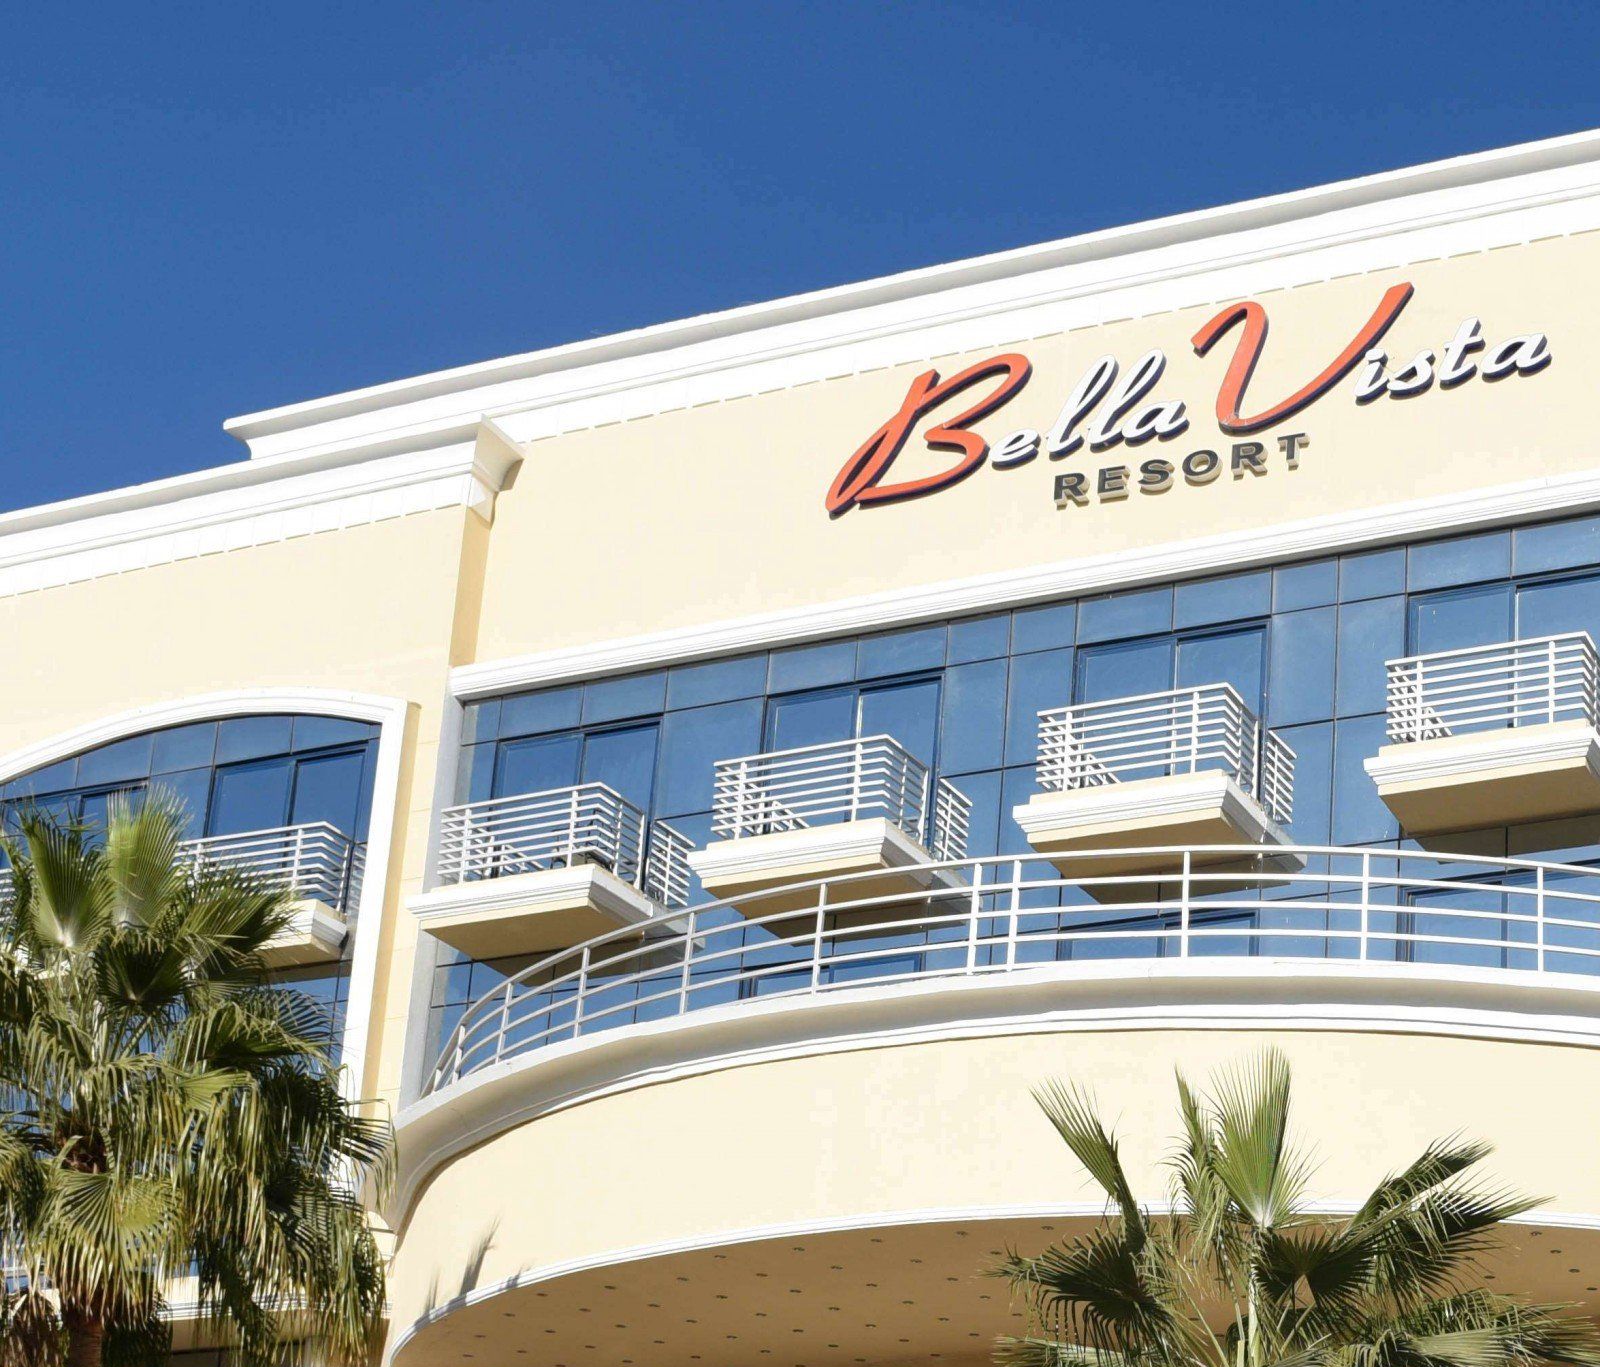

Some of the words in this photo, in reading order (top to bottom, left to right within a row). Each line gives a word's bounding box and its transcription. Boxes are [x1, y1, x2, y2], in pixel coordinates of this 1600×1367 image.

[825, 348, 1191, 519] Bella
[1192, 281, 1554, 436] Vista
[1053, 432, 1311, 506] RESORT
